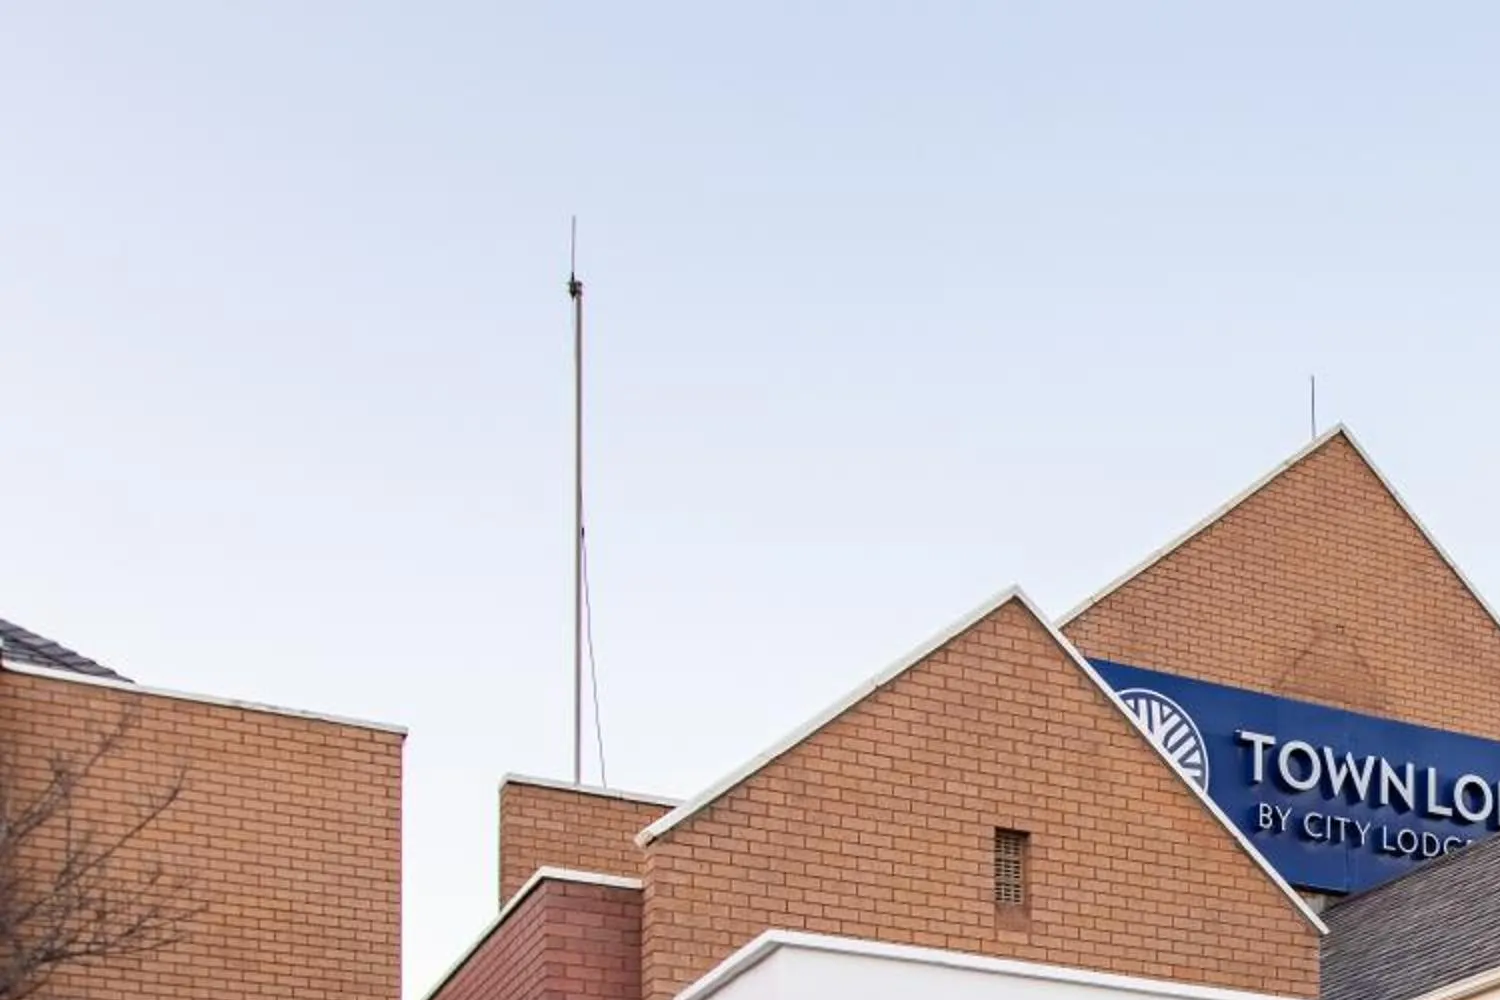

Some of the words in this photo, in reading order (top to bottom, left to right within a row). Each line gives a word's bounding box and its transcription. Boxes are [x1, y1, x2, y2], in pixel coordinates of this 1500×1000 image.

[1259, 803, 1293, 832] BY
[1303, 811, 1371, 846] CITY
[1383, 824, 1473, 858] LOD
